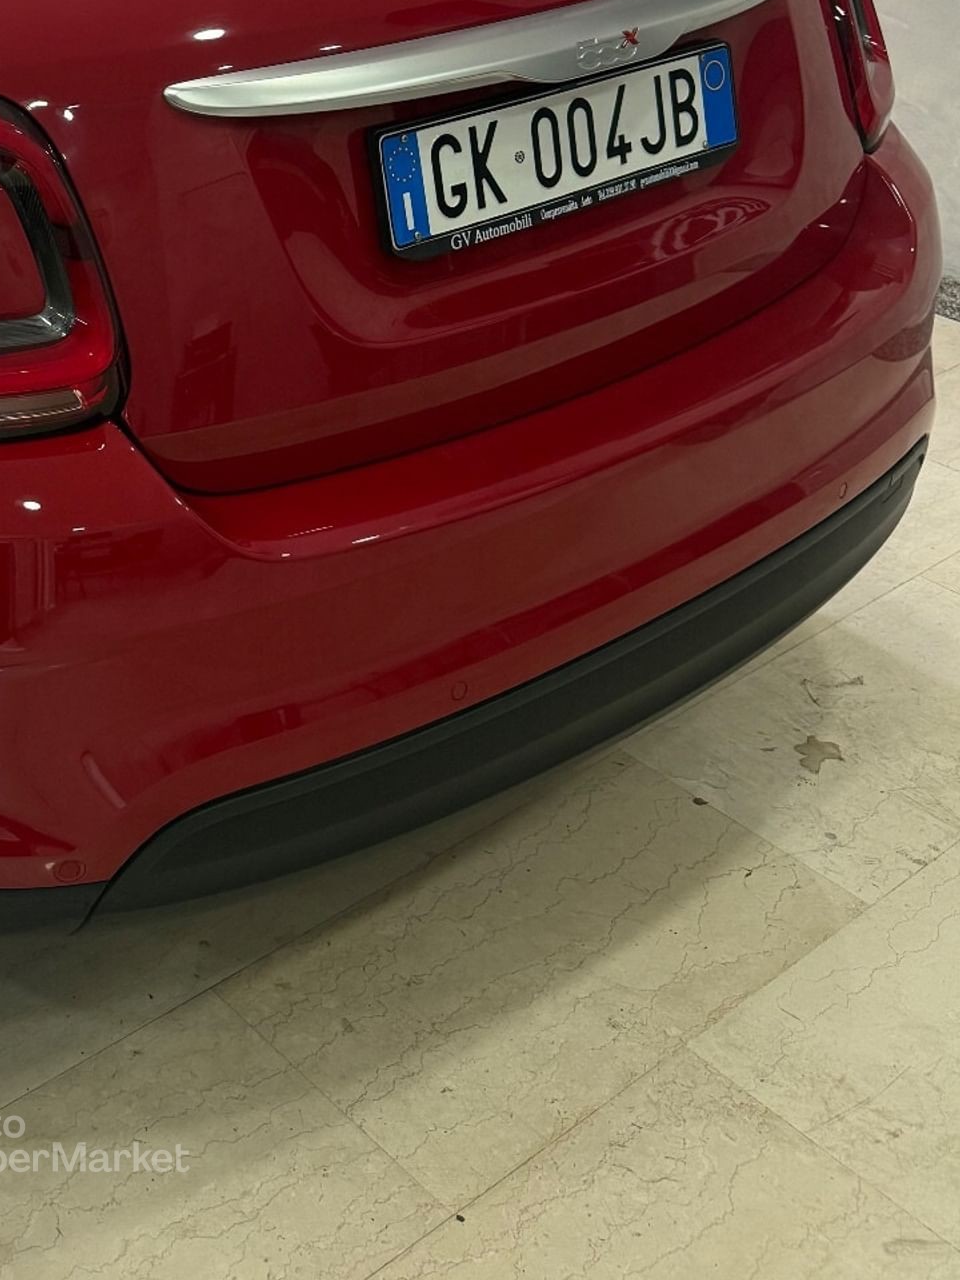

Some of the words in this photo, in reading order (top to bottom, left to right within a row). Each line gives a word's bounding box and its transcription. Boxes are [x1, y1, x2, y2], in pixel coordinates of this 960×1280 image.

[430, 120, 508, 219] GK
[450, 231, 471, 250] GV
[474, 213, 533, 244] Automobili
